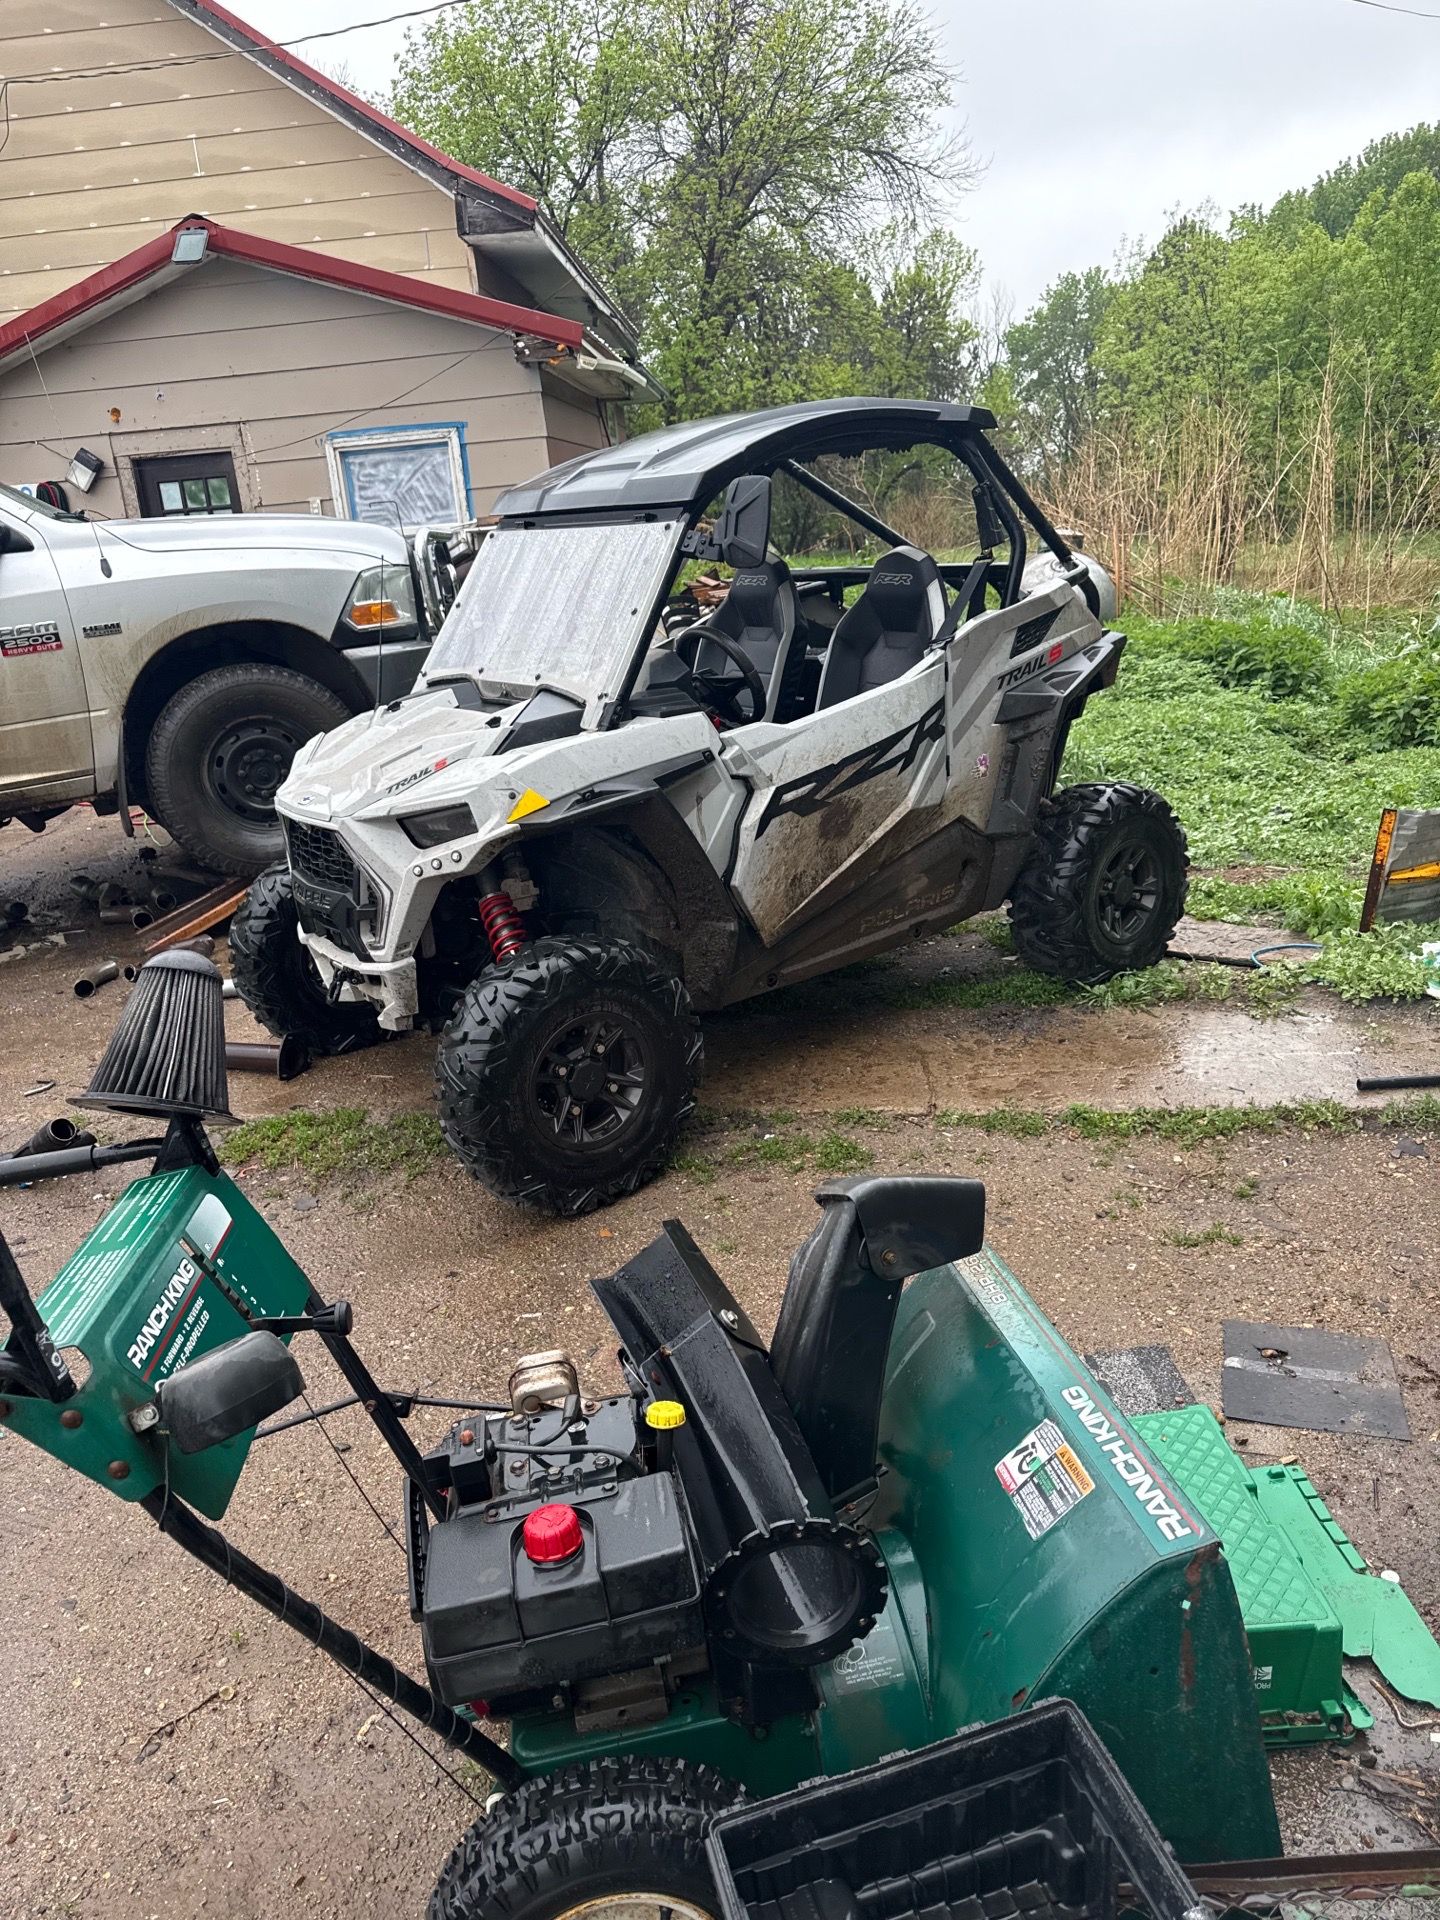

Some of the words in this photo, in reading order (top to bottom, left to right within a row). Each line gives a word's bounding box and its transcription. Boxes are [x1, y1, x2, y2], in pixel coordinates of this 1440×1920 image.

[736, 574, 768, 586] RZR
[874, 572, 913, 585] RZR
[82, 622, 120, 634] HEMI
[4, 635, 56, 648] 2500
[8, 646, 34, 655] HEAVY
[36, 642, 58, 651] DUTY
[997, 654, 1047, 690] TRAIL
[1048, 641, 1063, 665] S
[754, 696, 945, 841] RZR
[386, 767, 432, 794] TRAIL
[231, 1274, 238, 1282] 1
[241, 1285, 248, 1294] 2
[250, 1296, 257, 1305] 3
[160, 1366, 168, 1374] 5
[164, 1334, 185, 1371] FORWARD
[187, 1296, 205, 1324] REVERSE
[1064, 1459, 1091, 1492] WARNING
